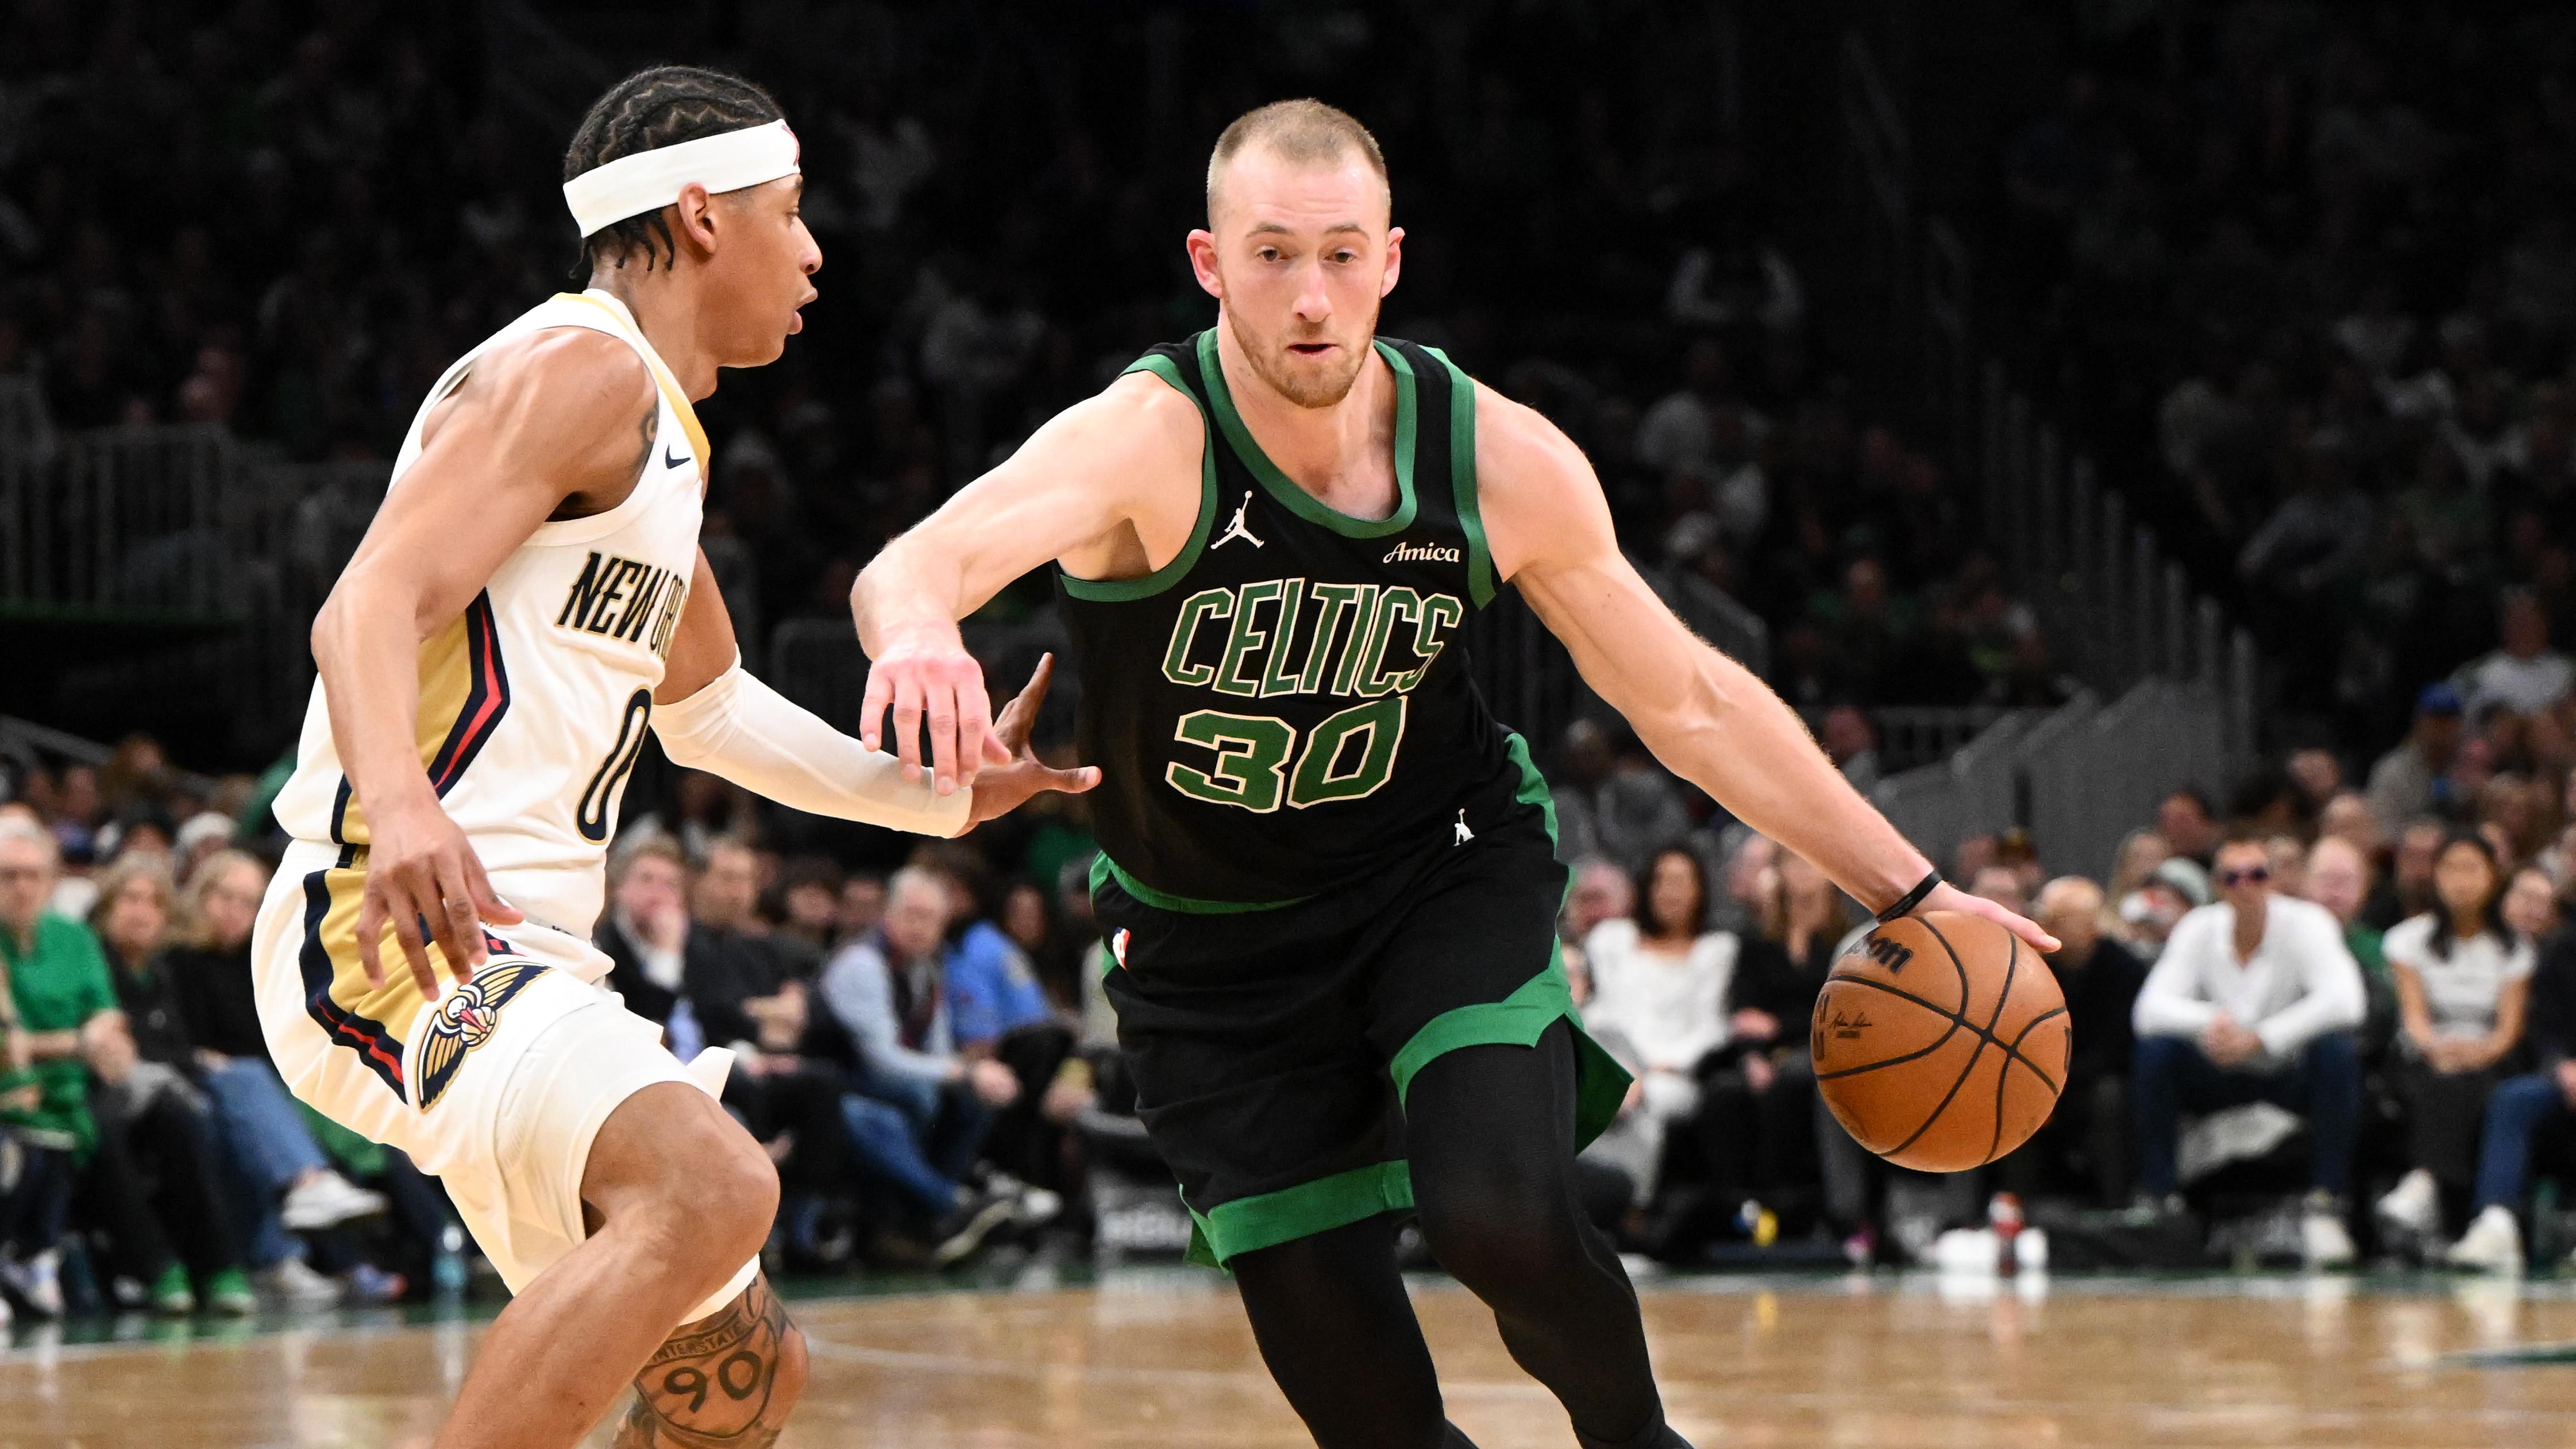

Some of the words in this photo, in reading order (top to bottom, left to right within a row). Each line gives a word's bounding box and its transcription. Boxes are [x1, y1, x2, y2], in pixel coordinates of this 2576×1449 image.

[554, 551, 668, 643] NEW
[1383, 542, 1459, 563] Amica
[1161, 577, 1463, 699] CELTICS
[574, 684, 654, 845] 0
[1165, 695, 1409, 814] 30
[664, 1351, 762, 1413] 90
